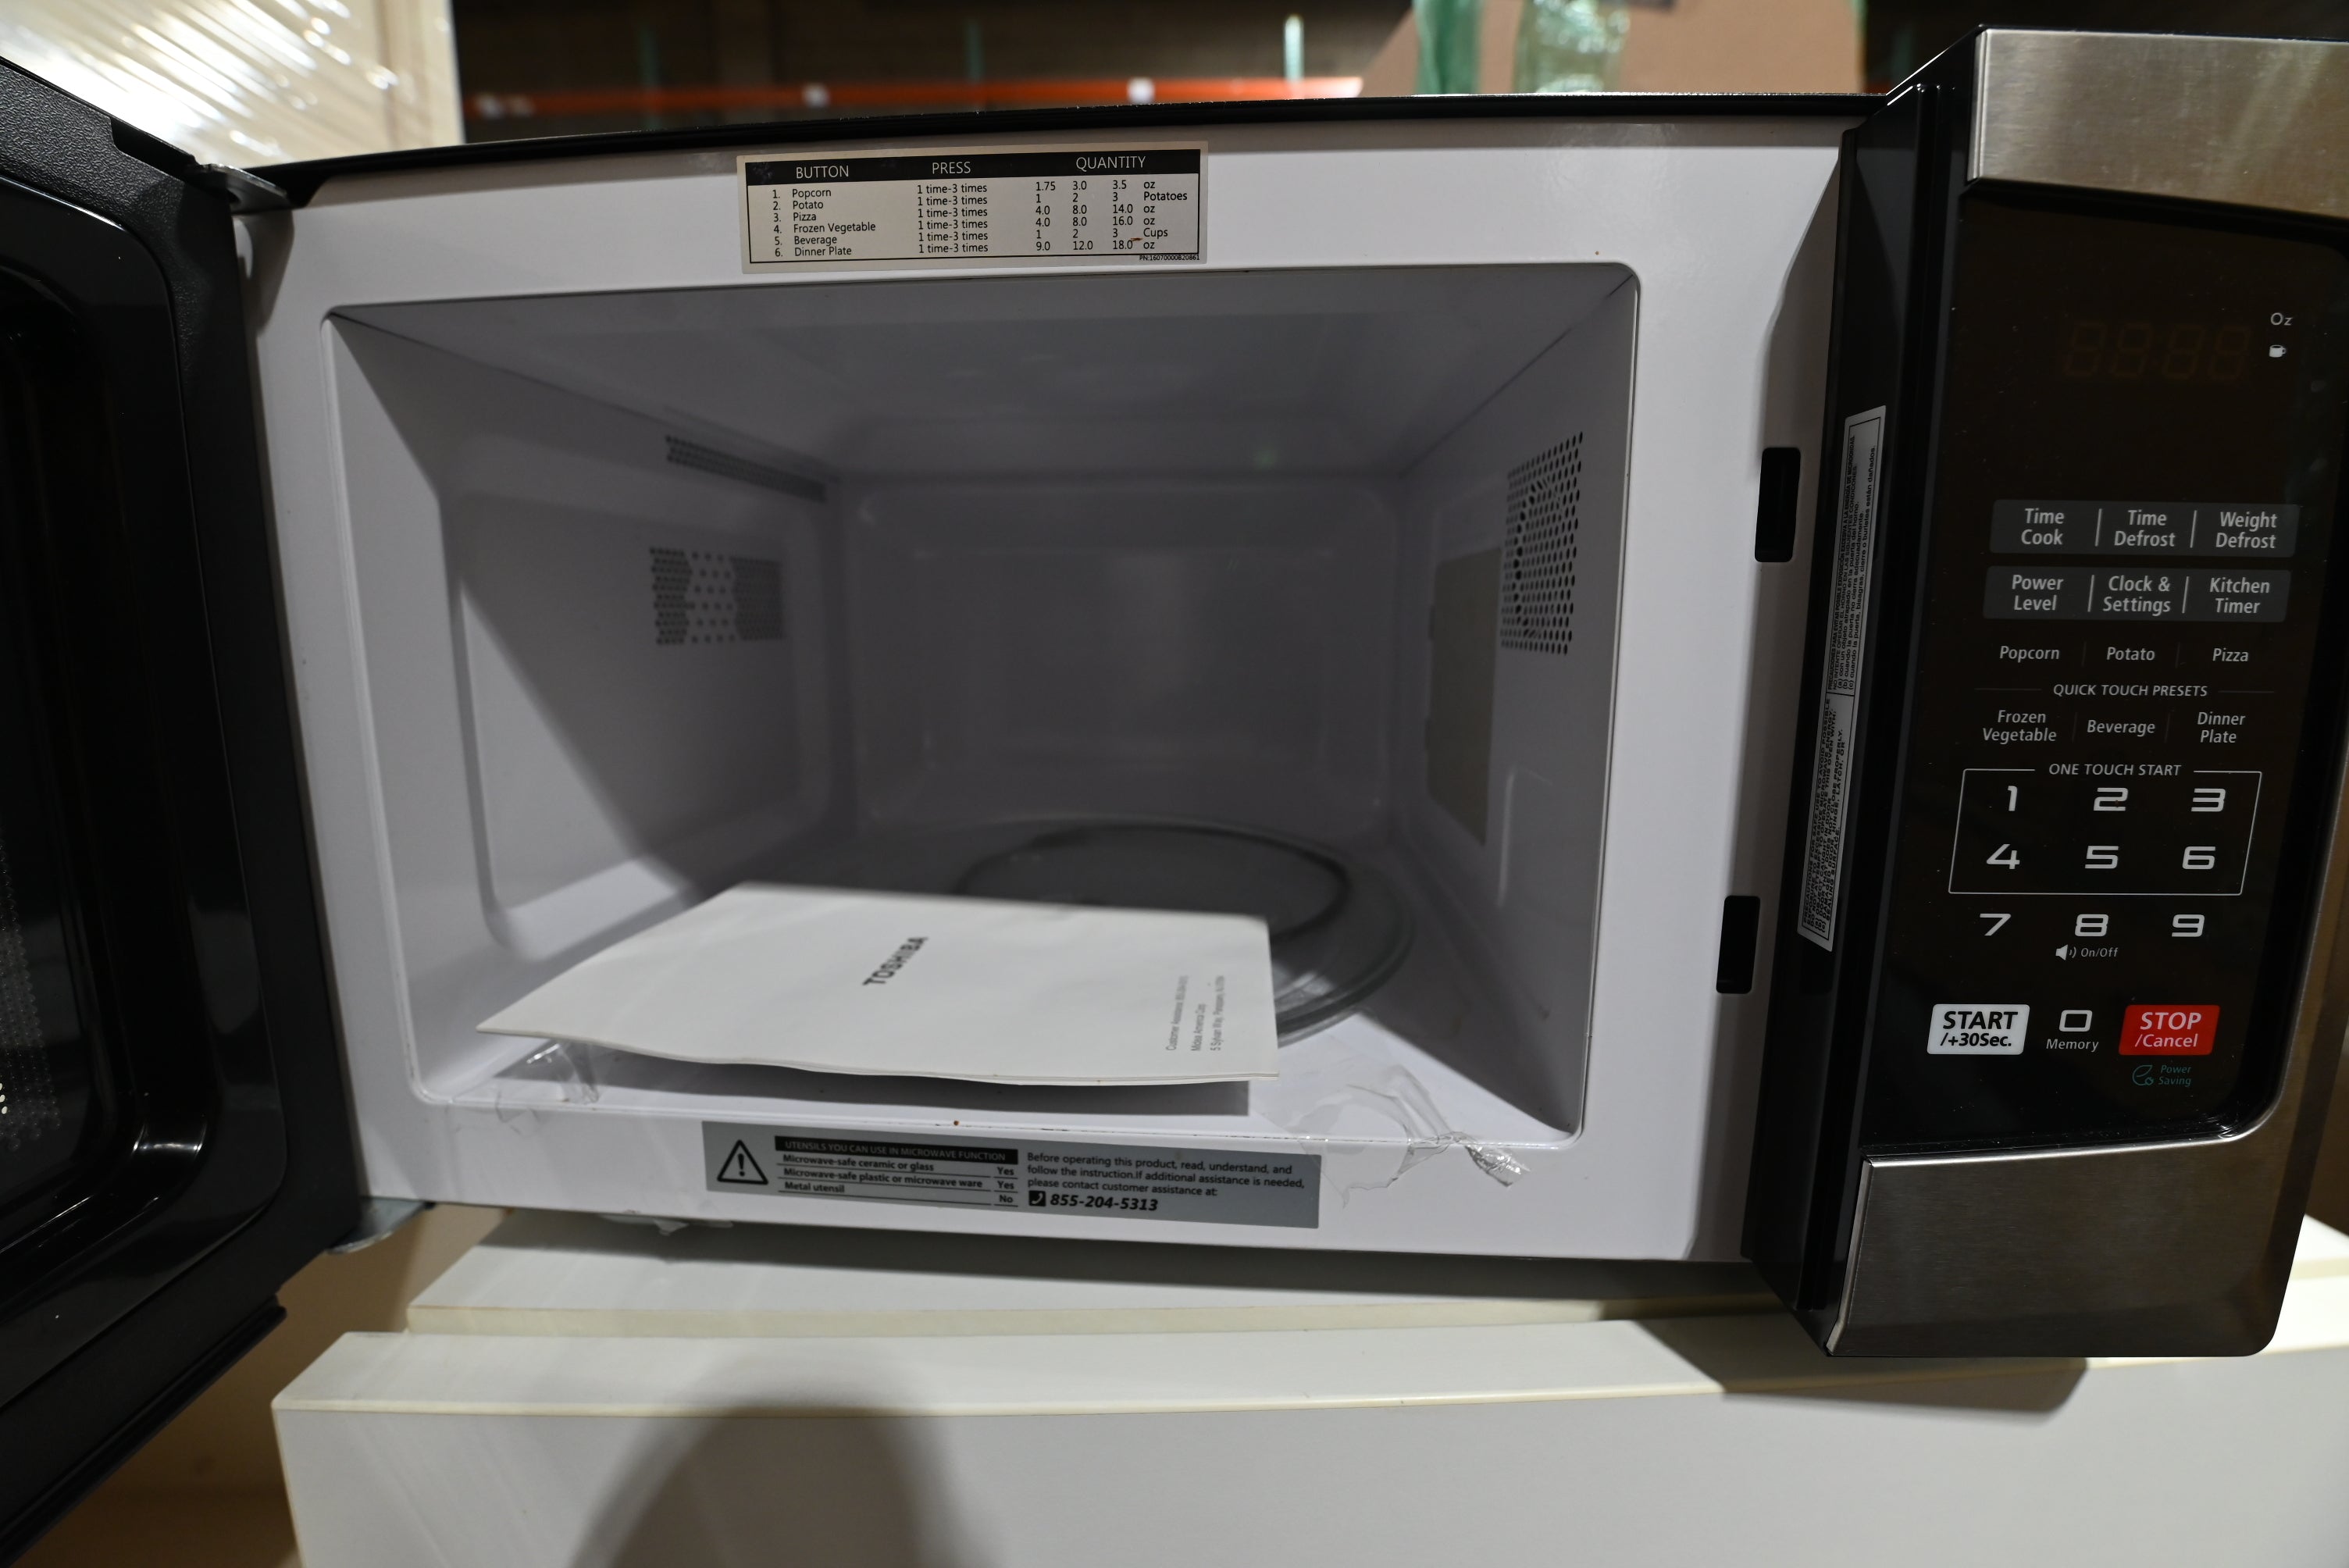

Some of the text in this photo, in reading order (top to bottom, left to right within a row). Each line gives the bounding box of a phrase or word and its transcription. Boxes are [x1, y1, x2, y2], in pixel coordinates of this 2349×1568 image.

[796, 156, 1146, 179] BUTTON PRESS QUANTITY
[792, 188, 832, 200] Popcorn
[918, 185, 922, 194] 1
[926, 184, 957, 194] time-3
[961, 184, 987, 193] times
[1035, 181, 1056, 191] 1.75
[1072, 180, 1087, 191] 3.0
[1113, 180, 1127, 190] 3.5
[793, 200, 824, 210] Potato
[918, 197, 923, 206] 1
[926, 196, 957, 205] time-3
[961, 195, 988, 205] times
[1036, 194, 1041, 203] 1
[1073, 193, 1078, 202] 2
[1113, 192, 1118, 201] 3
[1143, 191, 1188, 201] Potatoes
[793, 212, 817, 222] Pizza
[918, 208, 923, 218] 1
[927, 208, 958, 218] time-3
[962, 208, 988, 216] times
[1035, 205, 1050, 215] 4.0
[1072, 205, 1087, 214] 8.0
[1113, 204, 1133, 213] 14.0
[793, 223, 825, 233] Frozen
[828, 222, 876, 234] Vegetable
[918, 220, 924, 230] 1
[927, 220, 958, 230] time-3
[962, 219, 988, 229] times
[1035, 217, 1050, 226] 4.0
[1072, 217, 1087, 226] 8.0
[1113, 216, 1133, 226] 16.0
[794, 235, 837, 247] Beverage
[919, 233, 924, 241] 1
[928, 232, 958, 241] time-3
[962, 231, 988, 241] times
[1036, 230, 1042, 239] 1
[1073, 230, 1078, 238] 2
[1113, 229, 1118, 238] 3
[1143, 228, 1168, 240] Cups
[795, 247, 825, 256] Dinner
[829, 246, 852, 255] Plate
[919, 244, 924, 254] 1
[928, 244, 959, 253] time-3
[963, 244, 988, 252] times
[1036, 242, 1050, 251] 9.0
[1073, 241, 1093, 251] 12.0
[1113, 241, 1133, 250] 18.0
[2270, 312, 2293, 326] Oz
[2024, 508, 2065, 524] Time
[2128, 510, 2168, 526] Time
[2219, 511, 2277, 532] Weight
[2021, 529, 2064, 545] Cook
[2114, 530, 2176, 547] Defrost
[2215, 533, 2276, 548] Defrost
[2012, 575, 2064, 590] Power
[2108, 576, 2171, 592] Clock &
[2210, 577, 2270, 593] Kitchen
[2014, 595, 2058, 611] Level
[2103, 596, 2172, 617] Settings
[2215, 598, 2261, 614] Timer
[1999, 646, 2060, 663] Popcorn
[2106, 647, 2155, 661] Potato
[2212, 648, 2249, 661] Pizza
[2053, 684, 2208, 697] QUICK TOUCH PRESETS
[1998, 710, 2046, 724] Frozen
[2198, 712, 2245, 725] Dinner
[1983, 728, 2057, 745] Vegetable
[2087, 720, 2155, 737] Beverage
[2200, 730, 2237, 743] Plate
[2048, 764, 2181, 776] ONE TOUCH START
[2007, 786, 2226, 812] 1 2 3
[1987, 844, 2215, 869] 4 5 6
[1980, 914, 2205, 937] 7 8 9
[2081, 947, 2119, 958] On/Off
[1943, 1011, 2018, 1030] START
[2140, 1012, 2201, 1030] STOP
[1940, 1033, 2012, 1047] /+30Sec.
[2046, 1039, 2098, 1053] Memory
[2135, 1034, 2198, 1048] /Cancel
[2160, 1065, 2191, 1074] Power
[2158, 1076, 2191, 1087] Saving
[785, 1141, 826, 1151] UTENSILS
[828, 1143, 848, 1152] YOU
[849, 1145, 868, 1153] CAN
[870, 1146, 886, 1155] USE
[900, 1148, 957, 1159] MICROWAVE
[959, 1150, 1006, 1161] FUNCTION
[782, 1154, 857, 1167] Microwave-safe
[858, 1158, 895, 1169] ceramic
[910, 1162, 934, 1171] glass
[997, 1167, 1014, 1176] Yes
[1028, 1153, 1292, 1174] Before operating this product, read, understand, and
[784, 1167, 857, 1181] Microwave-safe
[859, 1172, 890, 1185] plastic
[904, 1175, 957, 1186] microwave
[997, 1181, 1014, 1189] Yes
[1028, 1165, 1058, 1175] follow
[1061, 1167, 1077, 1176] the
[1145, 1172, 1196, 1181] additional
[1199, 1175, 1249, 1185] assistance
[1264, 1178, 1305, 1188] needed,
[785, 1181, 1013, 1203] Metal utensil No
[1028, 1178, 1059, 1188] please
[1062, 1181, 1099, 1189] contact
[1102, 1183, 1149, 1192] customer
[1152, 1185, 1202, 1196] assistance
[1050, 1194, 1158, 1211] 855-204-5313
